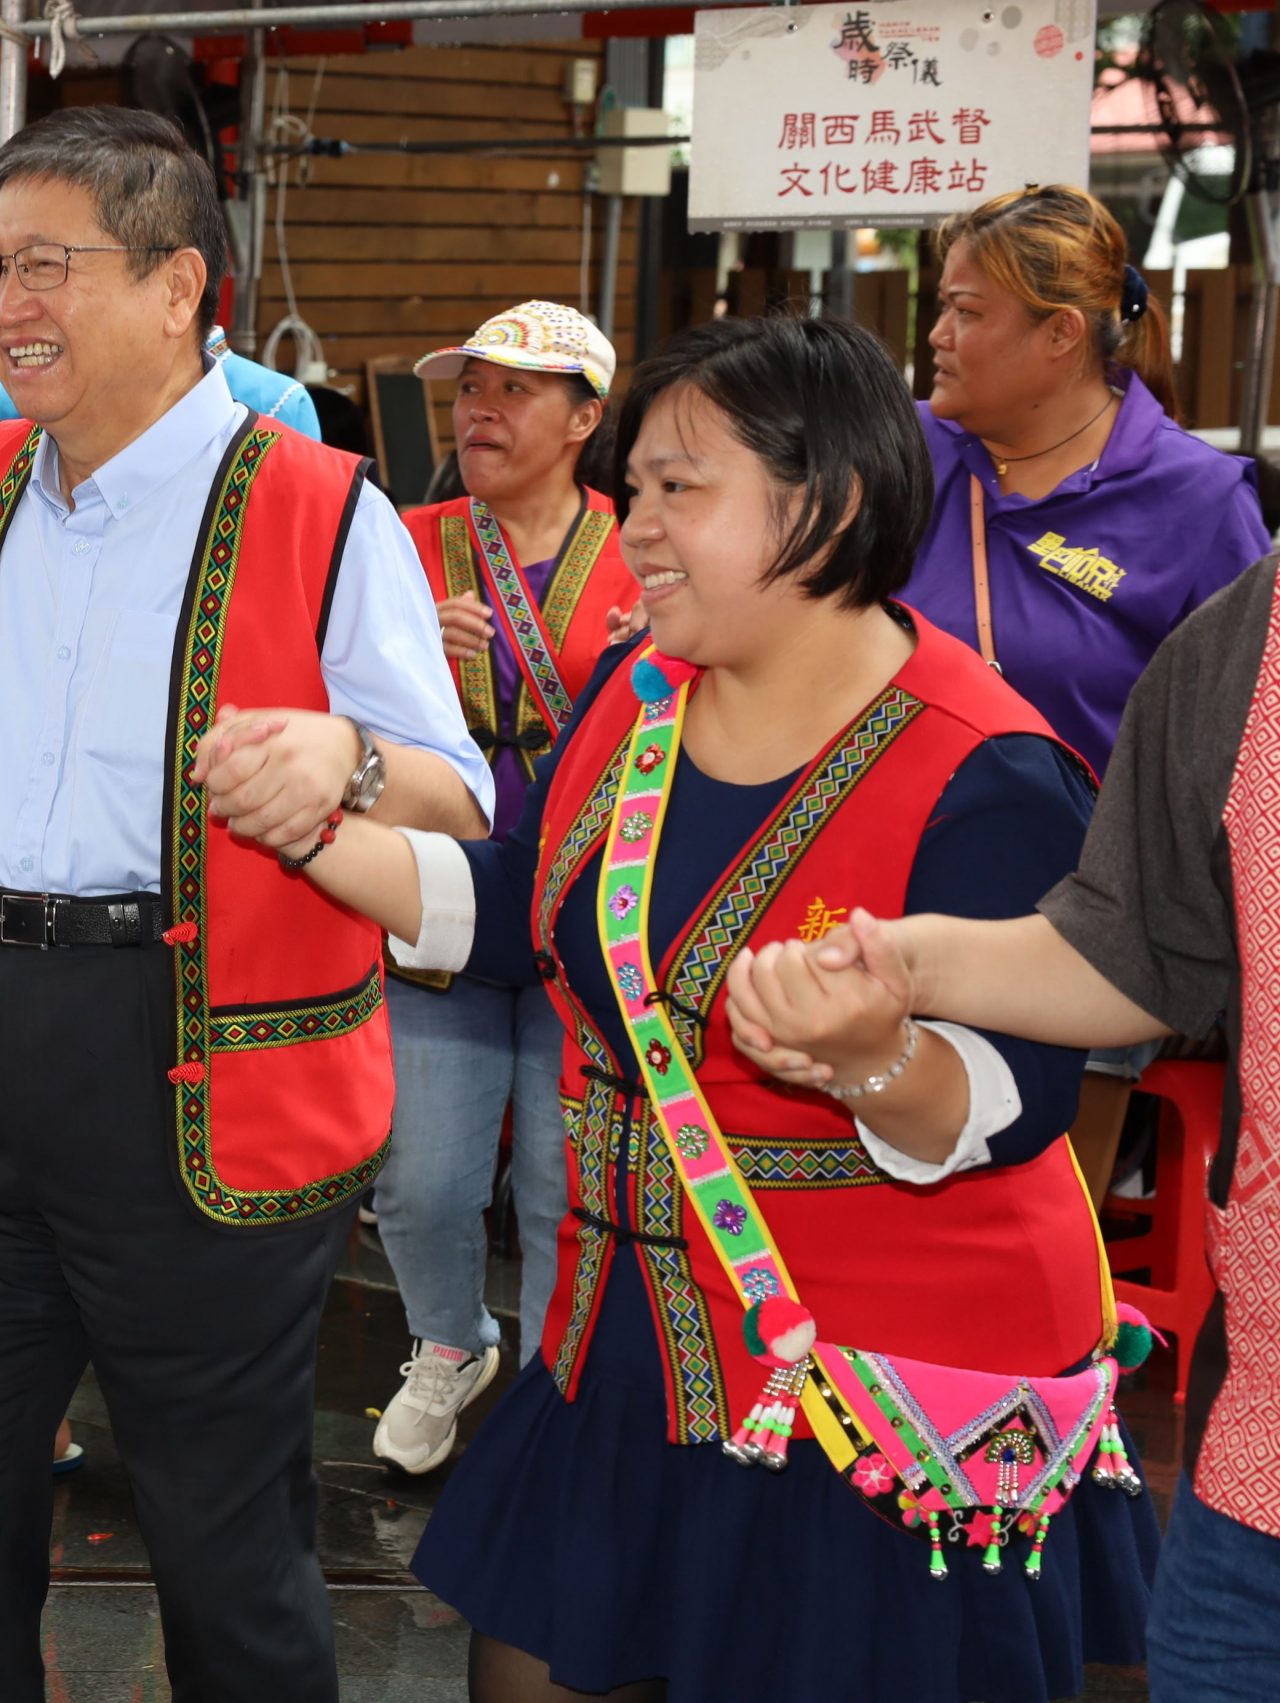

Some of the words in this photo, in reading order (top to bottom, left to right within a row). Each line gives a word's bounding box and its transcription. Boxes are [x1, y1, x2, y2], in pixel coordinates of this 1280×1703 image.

[778, 106, 992, 150] 關西馬武督
[777, 156, 988, 198] 文化健康站
[797, 895, 847, 944] 新
